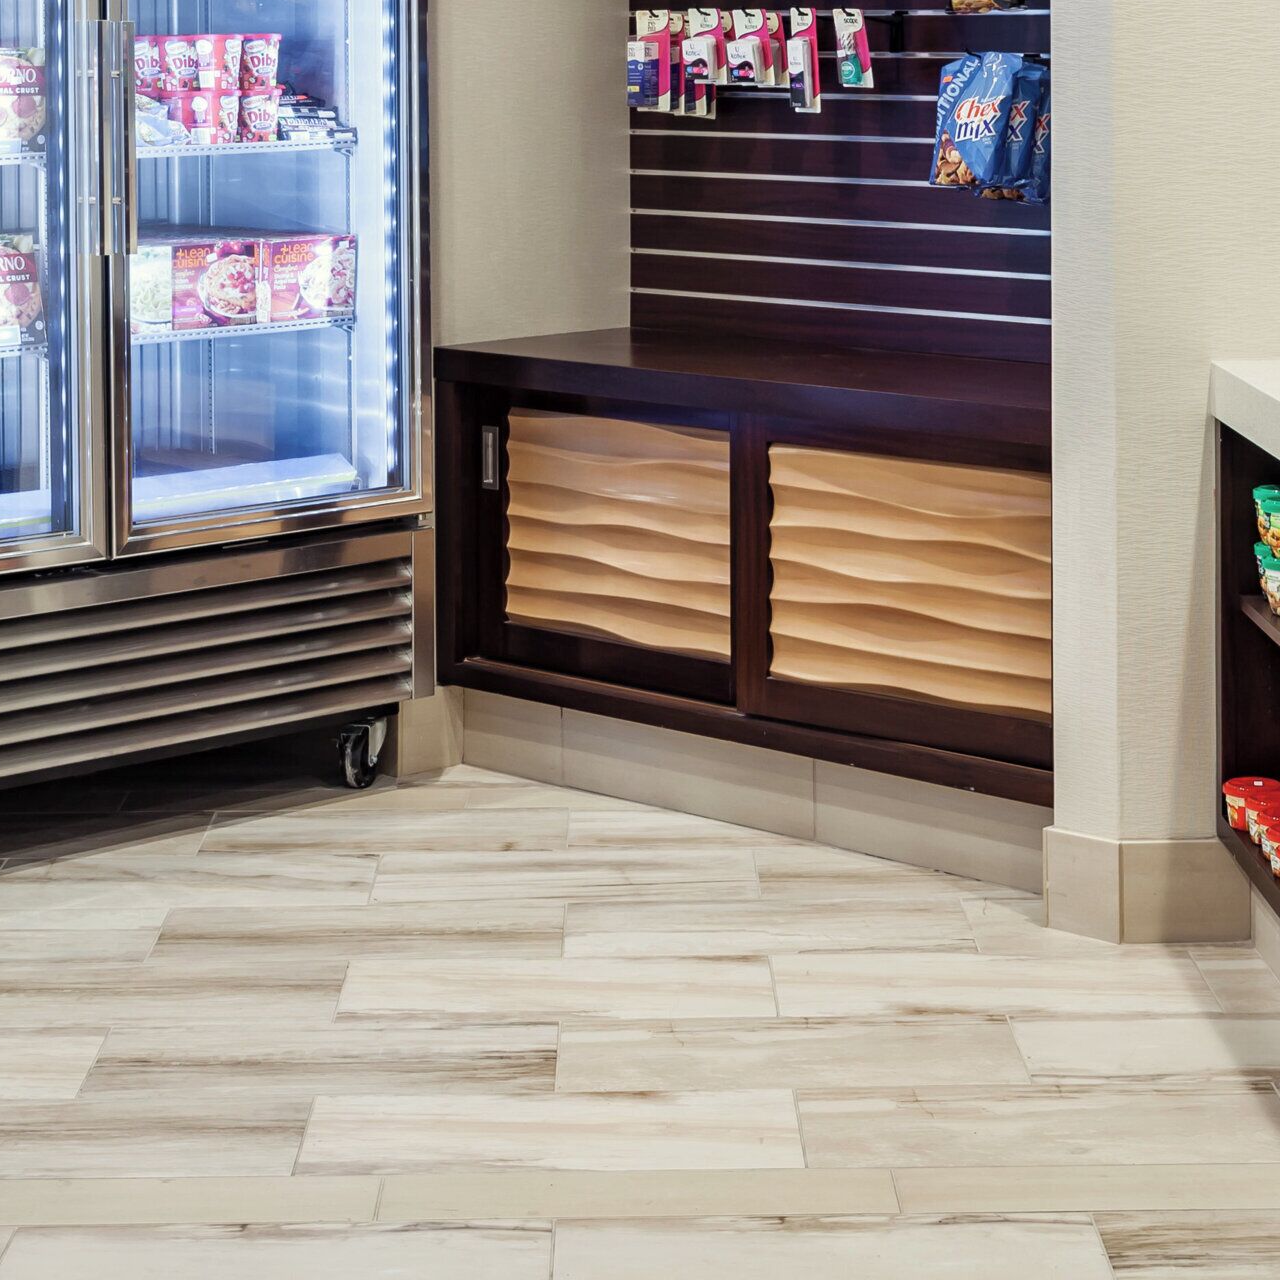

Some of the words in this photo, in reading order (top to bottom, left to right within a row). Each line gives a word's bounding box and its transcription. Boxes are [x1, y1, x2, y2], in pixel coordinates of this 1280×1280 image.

[249, 53, 276, 69] Dibs
[16, 86, 39, 94] CRUST
[246, 108, 276, 123] Dibs
[956, 97, 1004, 120] Chex
[957, 115, 997, 141] mix
[7, 274, 31, 282] CRUST
